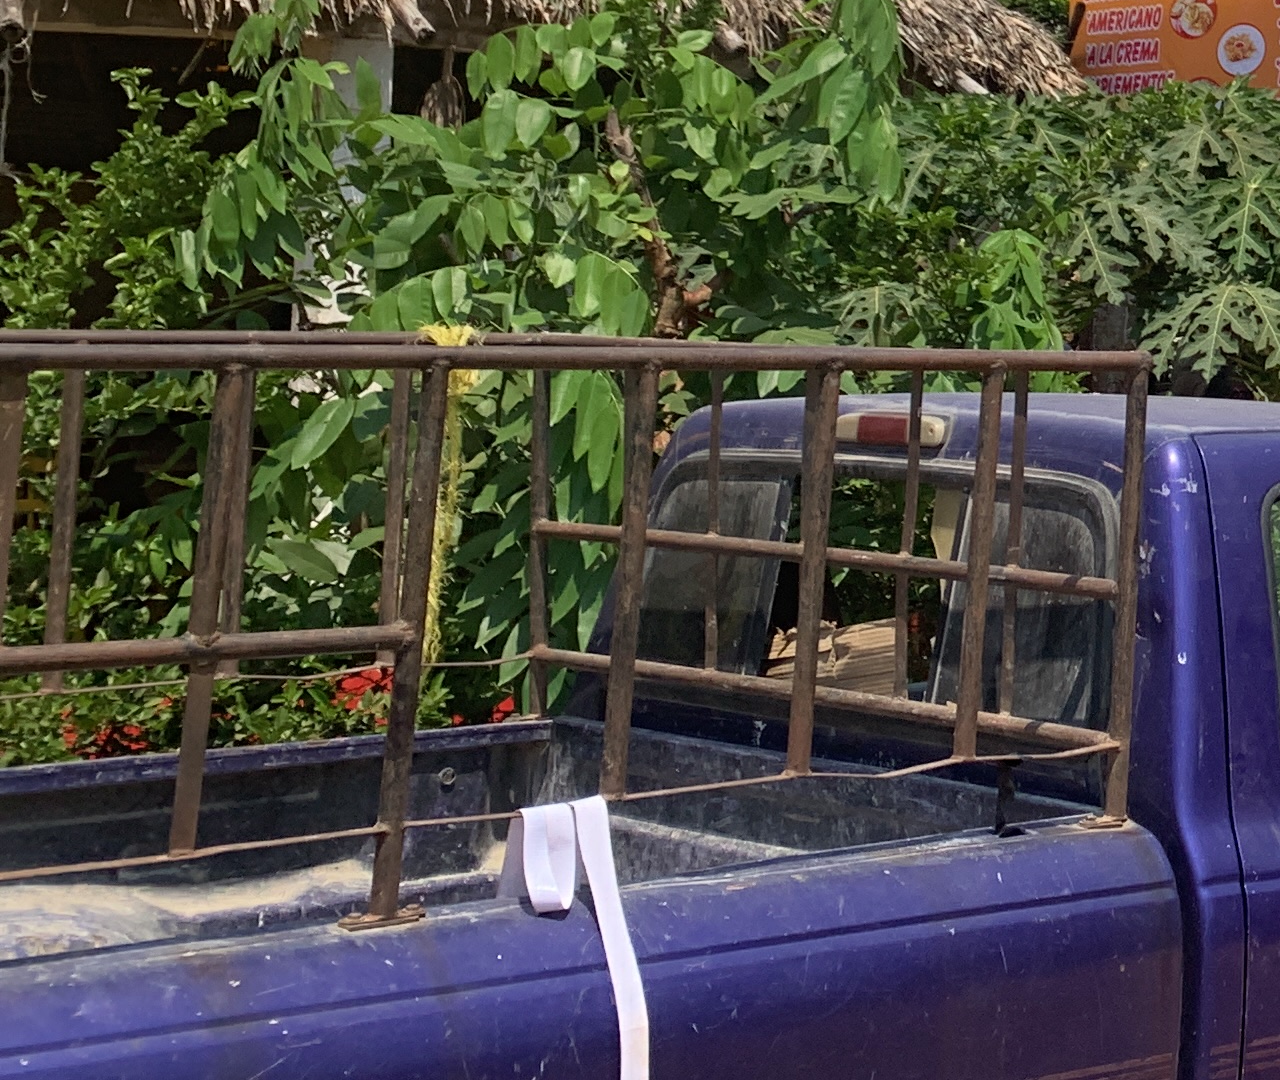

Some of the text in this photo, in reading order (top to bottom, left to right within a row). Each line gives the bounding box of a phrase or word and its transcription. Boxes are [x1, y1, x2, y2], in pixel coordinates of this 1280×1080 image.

[1088, 7, 1162, 33] AMERICANO
[1088, 40, 1158, 65] A LA CREMA
